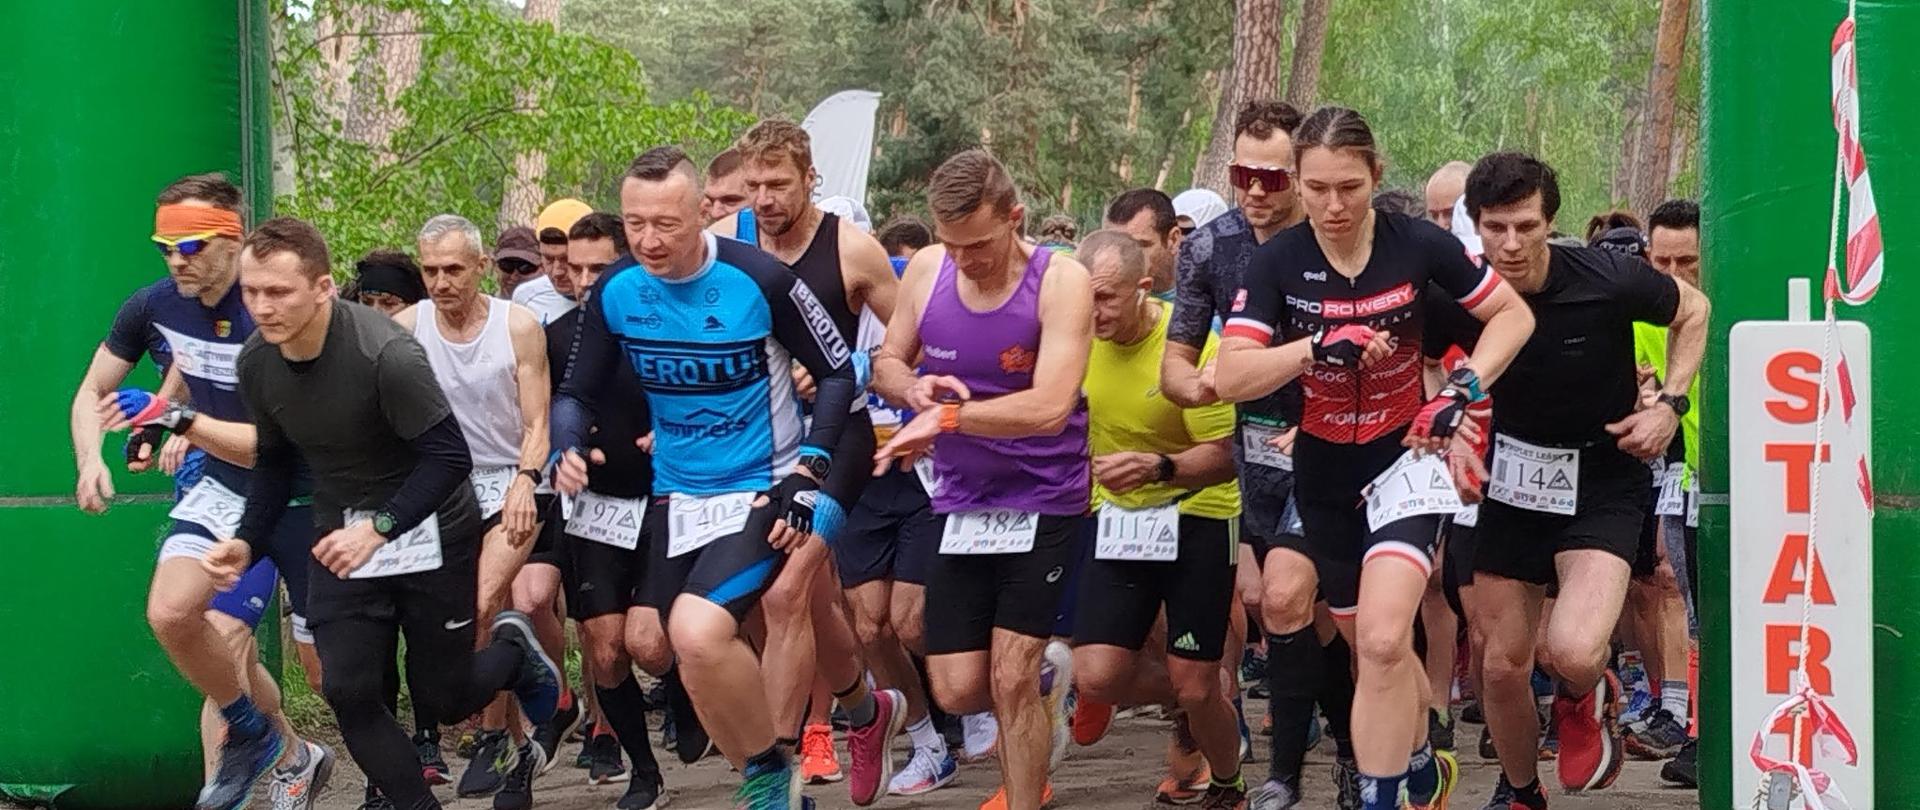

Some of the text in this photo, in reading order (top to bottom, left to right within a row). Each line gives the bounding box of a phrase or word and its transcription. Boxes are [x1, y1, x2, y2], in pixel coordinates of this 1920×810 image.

[796, 284, 849, 360] BEROTU
[1401, 471, 1416, 495] 1
[1517, 463, 1547, 491] 14
[473, 480, 502, 504] 25
[591, 501, 620, 526] 97
[974, 511, 1011, 536] 38
[1118, 514, 1160, 541] 117
[1763, 351, 1837, 770] START
